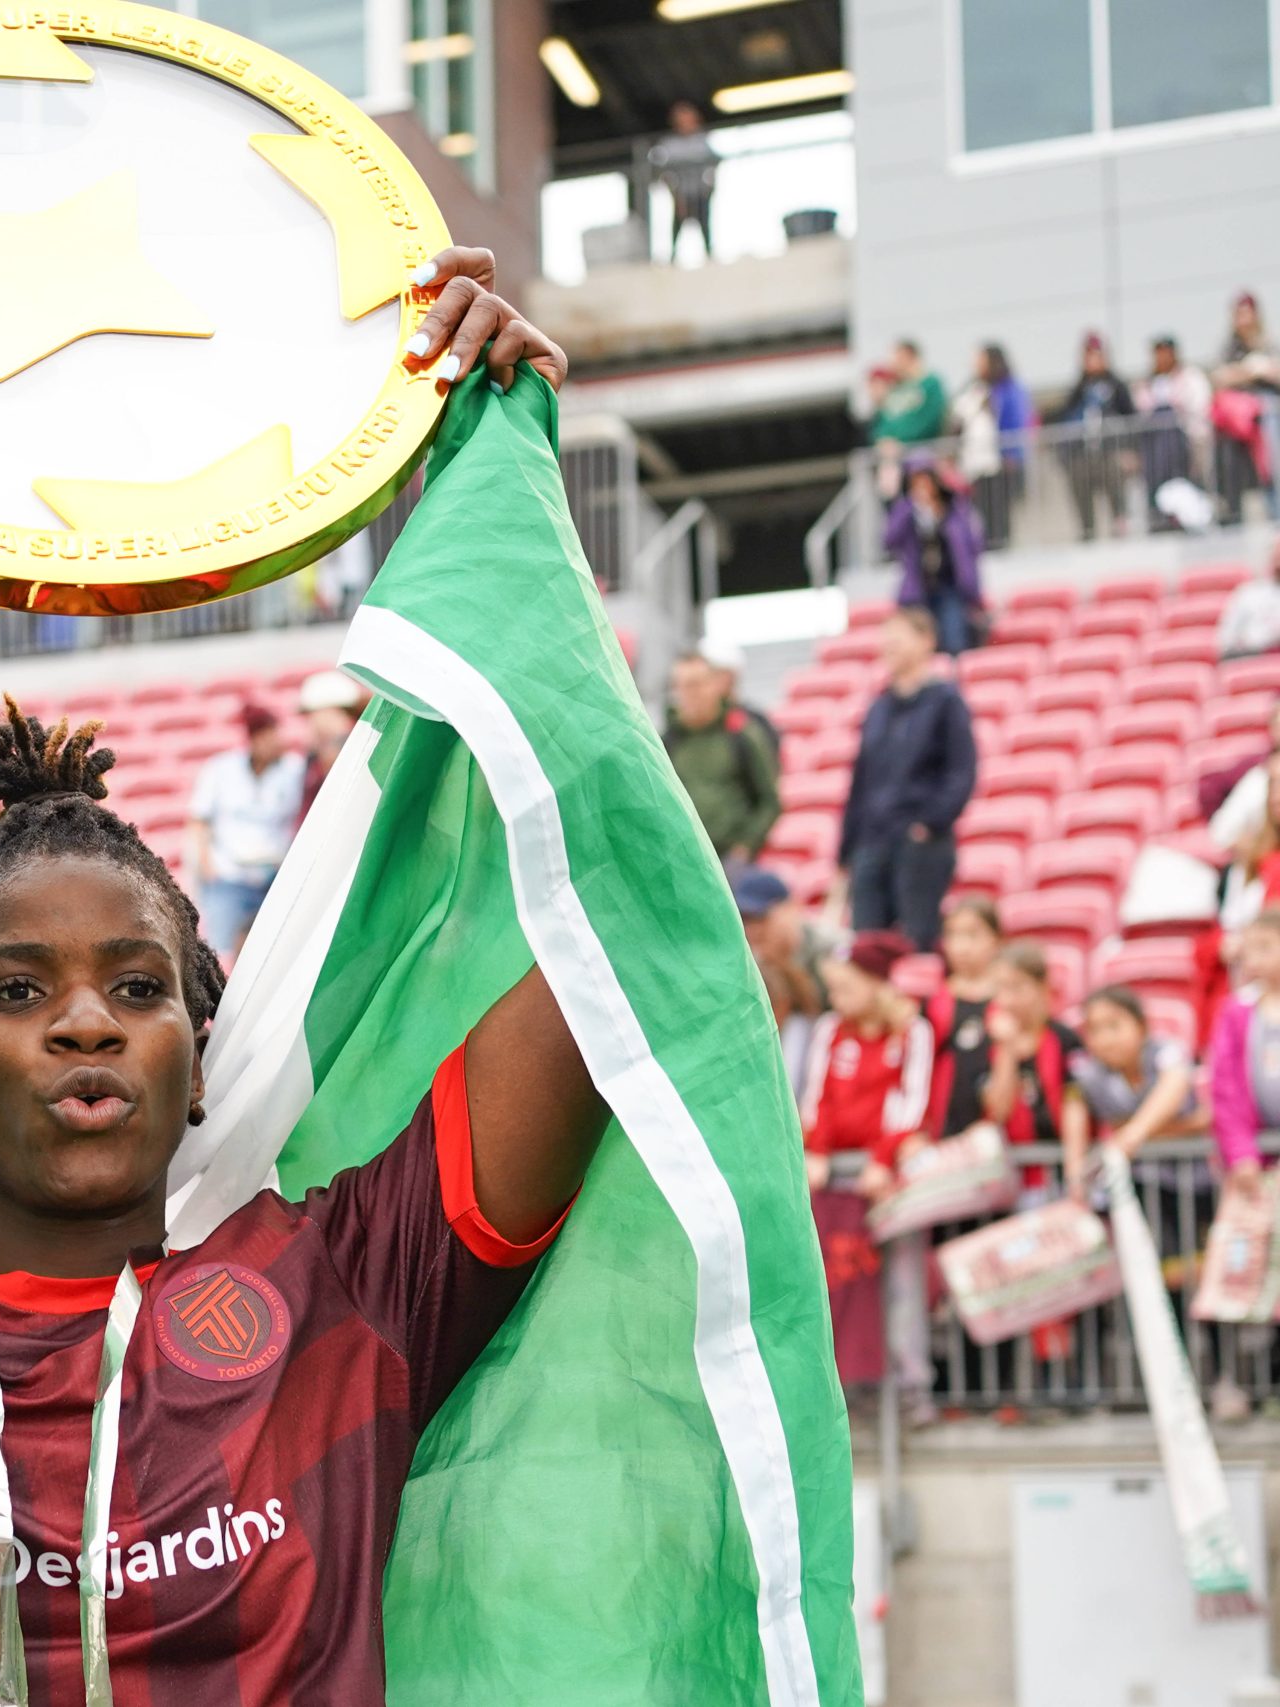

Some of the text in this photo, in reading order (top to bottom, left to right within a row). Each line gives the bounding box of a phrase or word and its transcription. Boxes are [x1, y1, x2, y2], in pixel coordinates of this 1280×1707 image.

[110, 16, 252, 78] LEAGUE
[28, 532, 170, 561] SUPER
[176, 497, 289, 554] LIGUE
[285, 467, 338, 513] DU
[330, 399, 406, 479] NORD
[240, 1271, 285, 1333] FOOTBALL CLUB
[156, 1315, 198, 1370] ASSOCIATION
[217, 1345, 279, 1378] TORONTO
